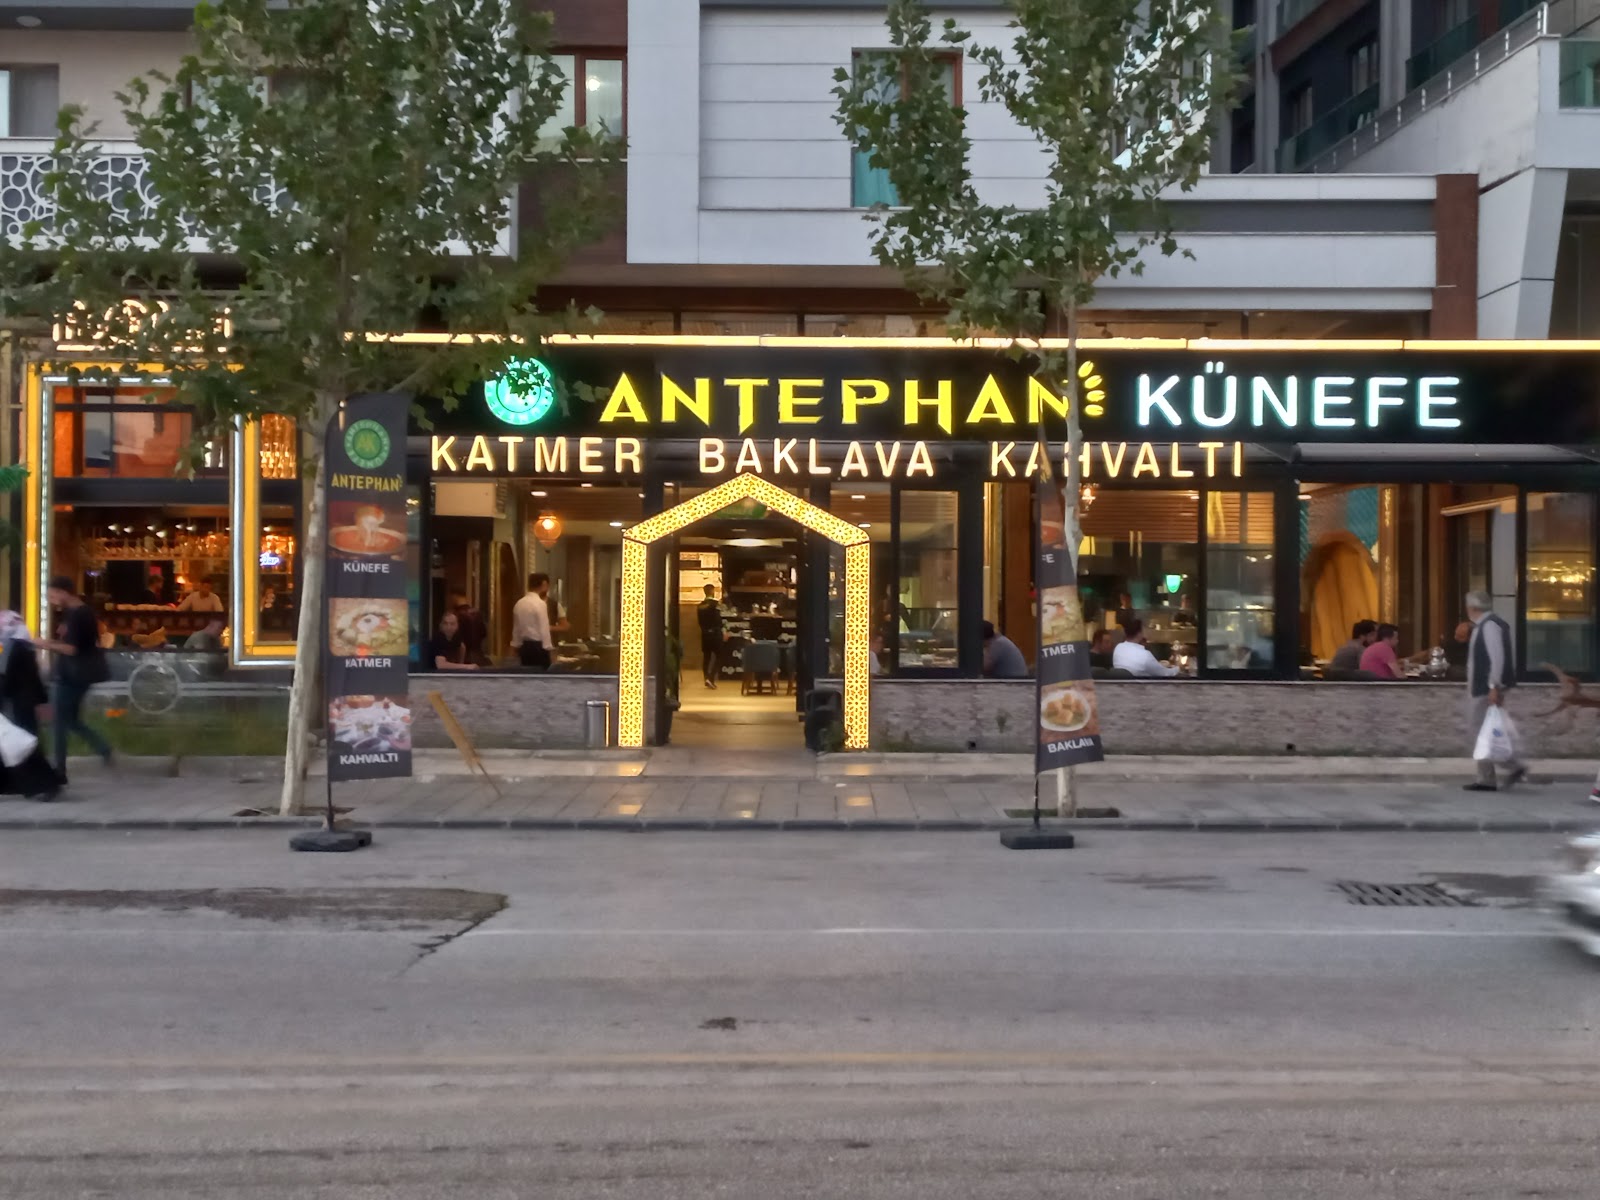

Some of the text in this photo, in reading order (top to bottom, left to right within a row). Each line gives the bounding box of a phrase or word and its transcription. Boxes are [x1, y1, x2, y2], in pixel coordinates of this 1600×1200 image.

[599, 372, 1070, 434] ANTEPHAN
[1137, 361, 1462, 428] KÜNEFE
[431, 436, 642, 474] KATMER
[699, 437, 935, 478] BAKLAVA
[991, 441, 1243, 478] KAHVALTI
[331, 472, 400, 492] ANTEPHAN
[343, 560, 390, 574] KÜNEFE
[1042, 643, 1075, 658] TMER
[340, 752, 399, 765] KAHVALTI
